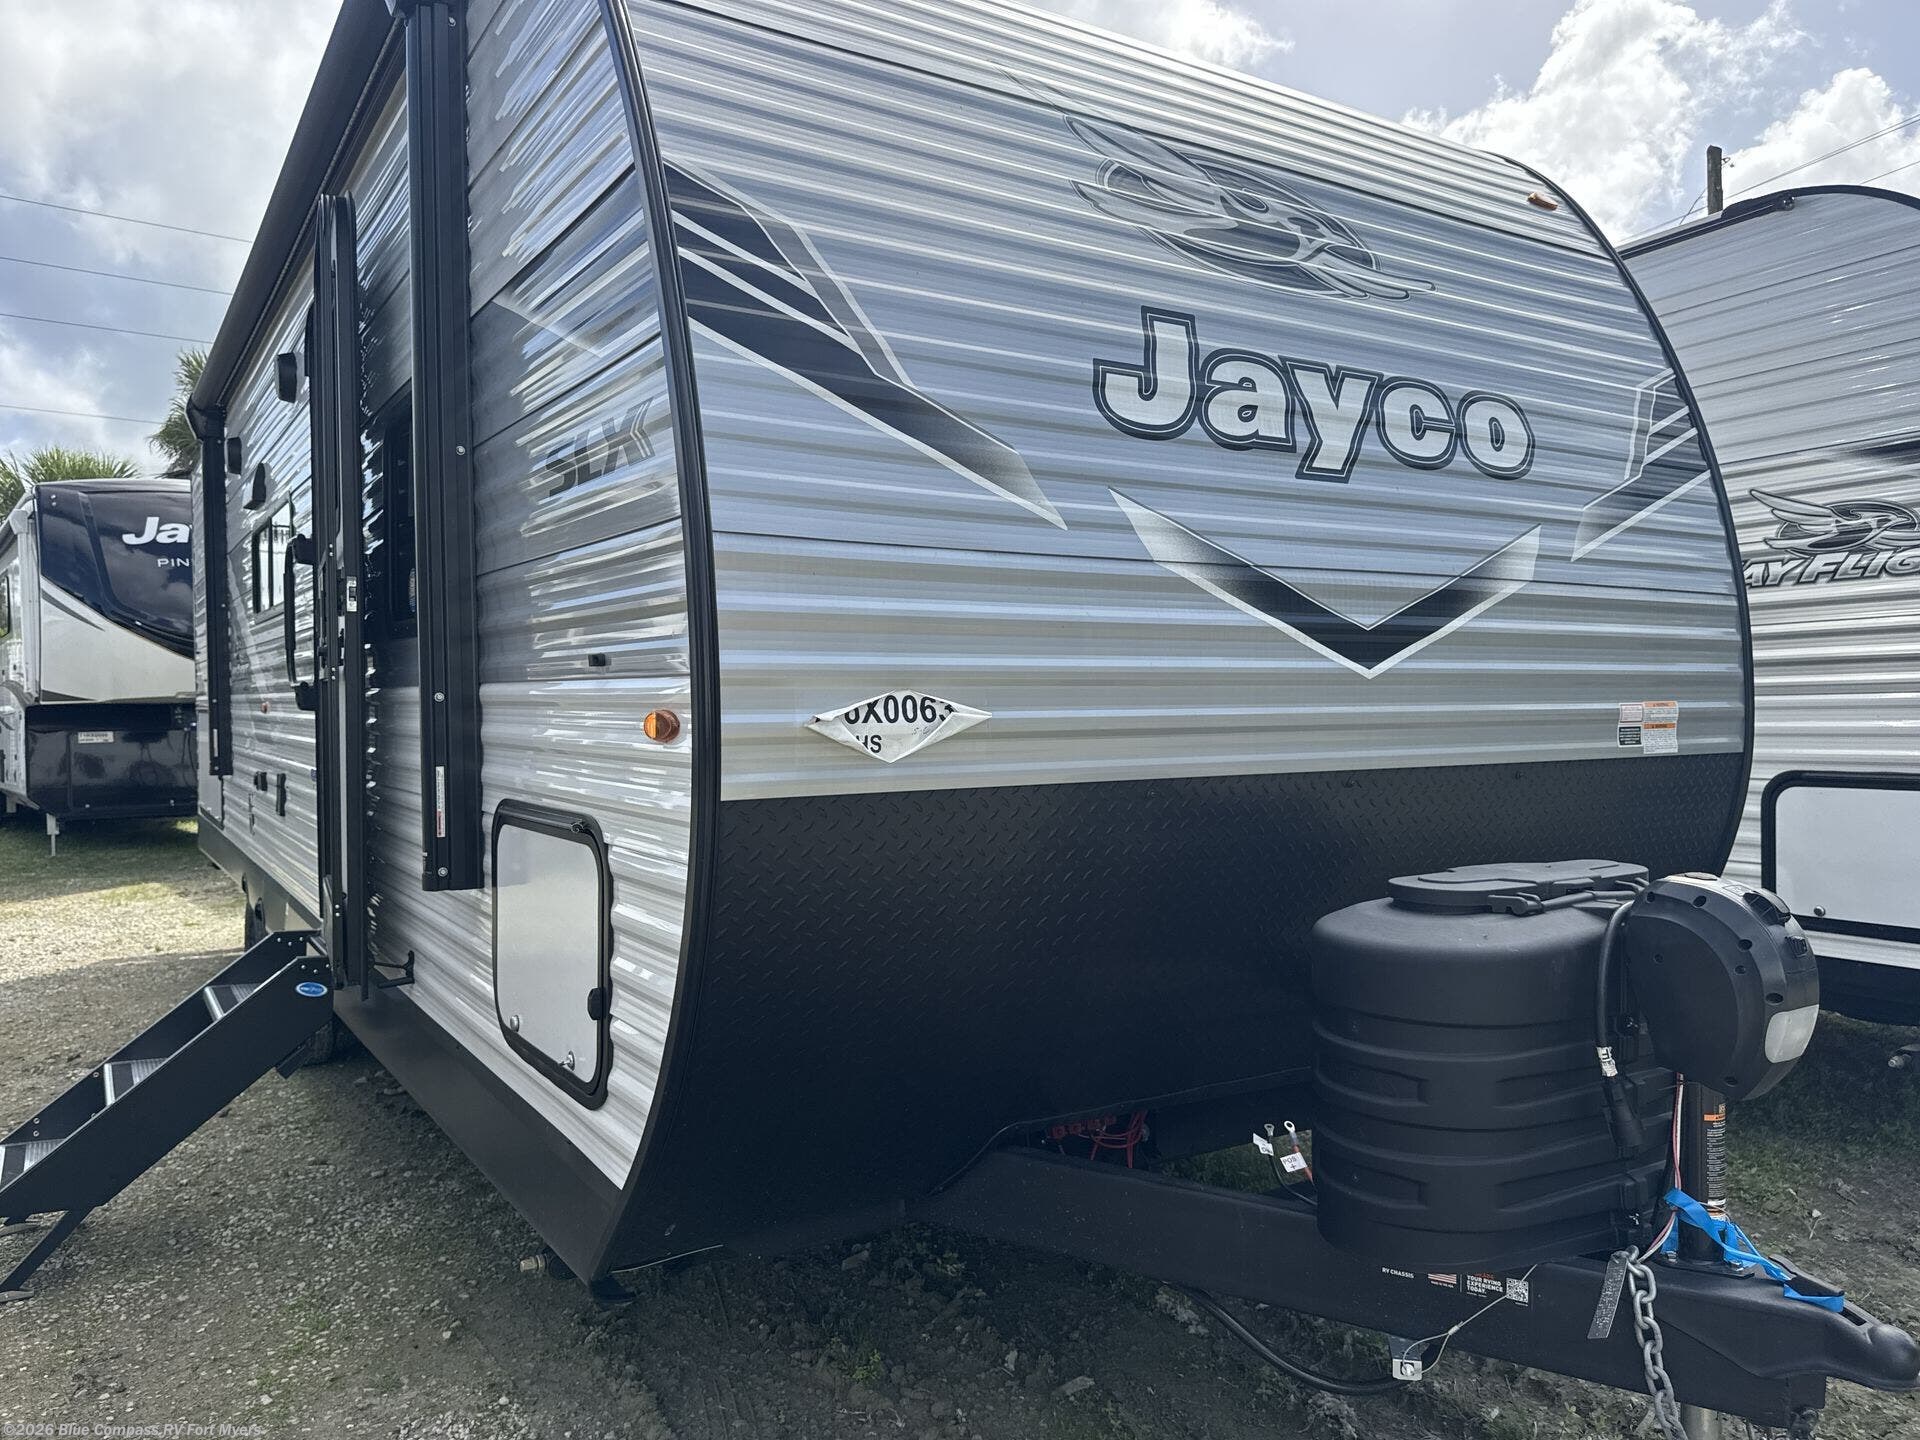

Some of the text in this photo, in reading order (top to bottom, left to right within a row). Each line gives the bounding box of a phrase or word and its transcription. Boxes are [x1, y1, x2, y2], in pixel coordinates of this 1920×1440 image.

[1092, 305, 1536, 484] Jayco
[545, 396, 656, 498] SLX
[122, 516, 192, 545] Ja
[1467, 1280, 1503, 1293] EXPERIENCE
